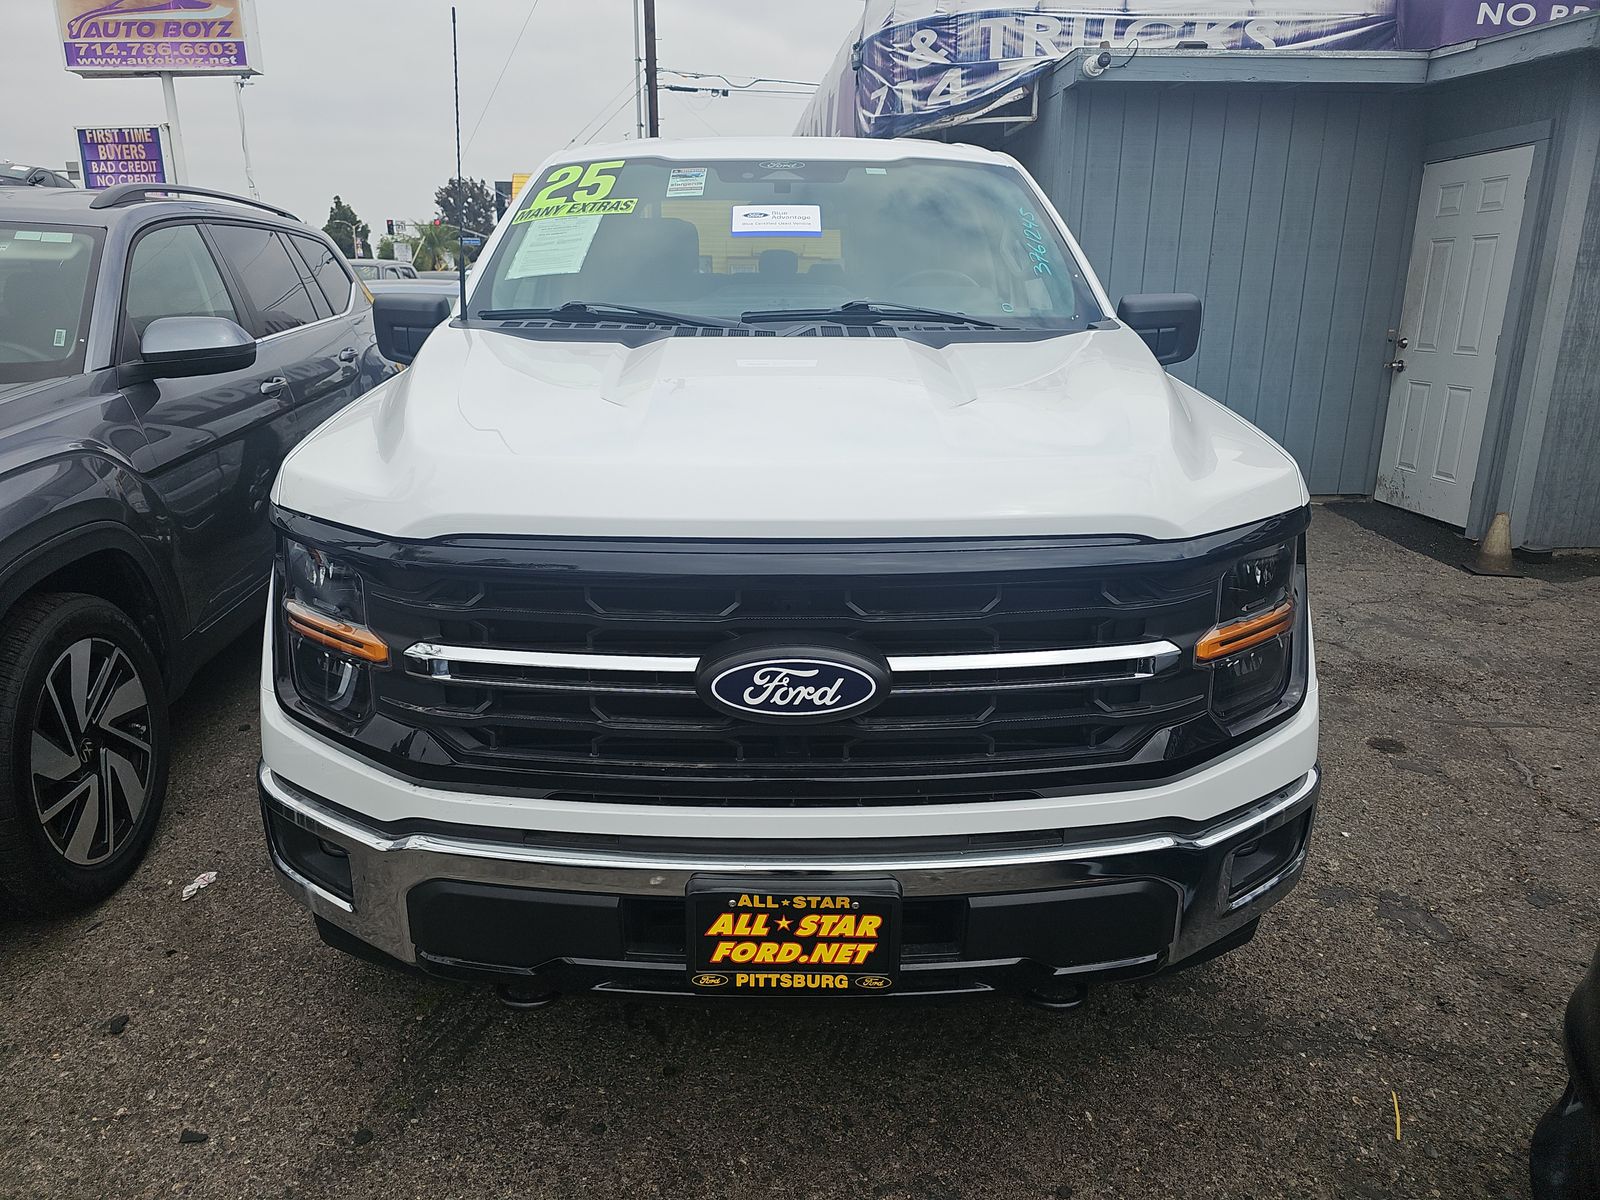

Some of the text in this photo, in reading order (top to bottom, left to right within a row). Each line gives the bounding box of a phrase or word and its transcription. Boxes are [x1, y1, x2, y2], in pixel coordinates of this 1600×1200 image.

[1477, 2, 1537, 26] NO
[83, 20, 235, 38] AUTO BOYZ
[75, 43, 238, 56] 714.786.6603
[77, 56, 238, 66] www.autoboyz.net
[85, 128, 153, 144] FIRST TIME
[98, 144, 146, 160] BUYERS
[91, 161, 157, 173] BAD CREDIT
[96, 174, 157, 187] NO CREDIT
[530, 160, 626, 209] 25
[514, 200, 634, 222] MANY EXTRAS
[743, 667, 845, 706] Ford
[737, 894, 850, 909] ALL STAR
[704, 913, 883, 938] ALL STAR
[709, 941, 878, 964] FORD.NET
[699, 973, 885, 988] Ford PITTSBURG Ford
